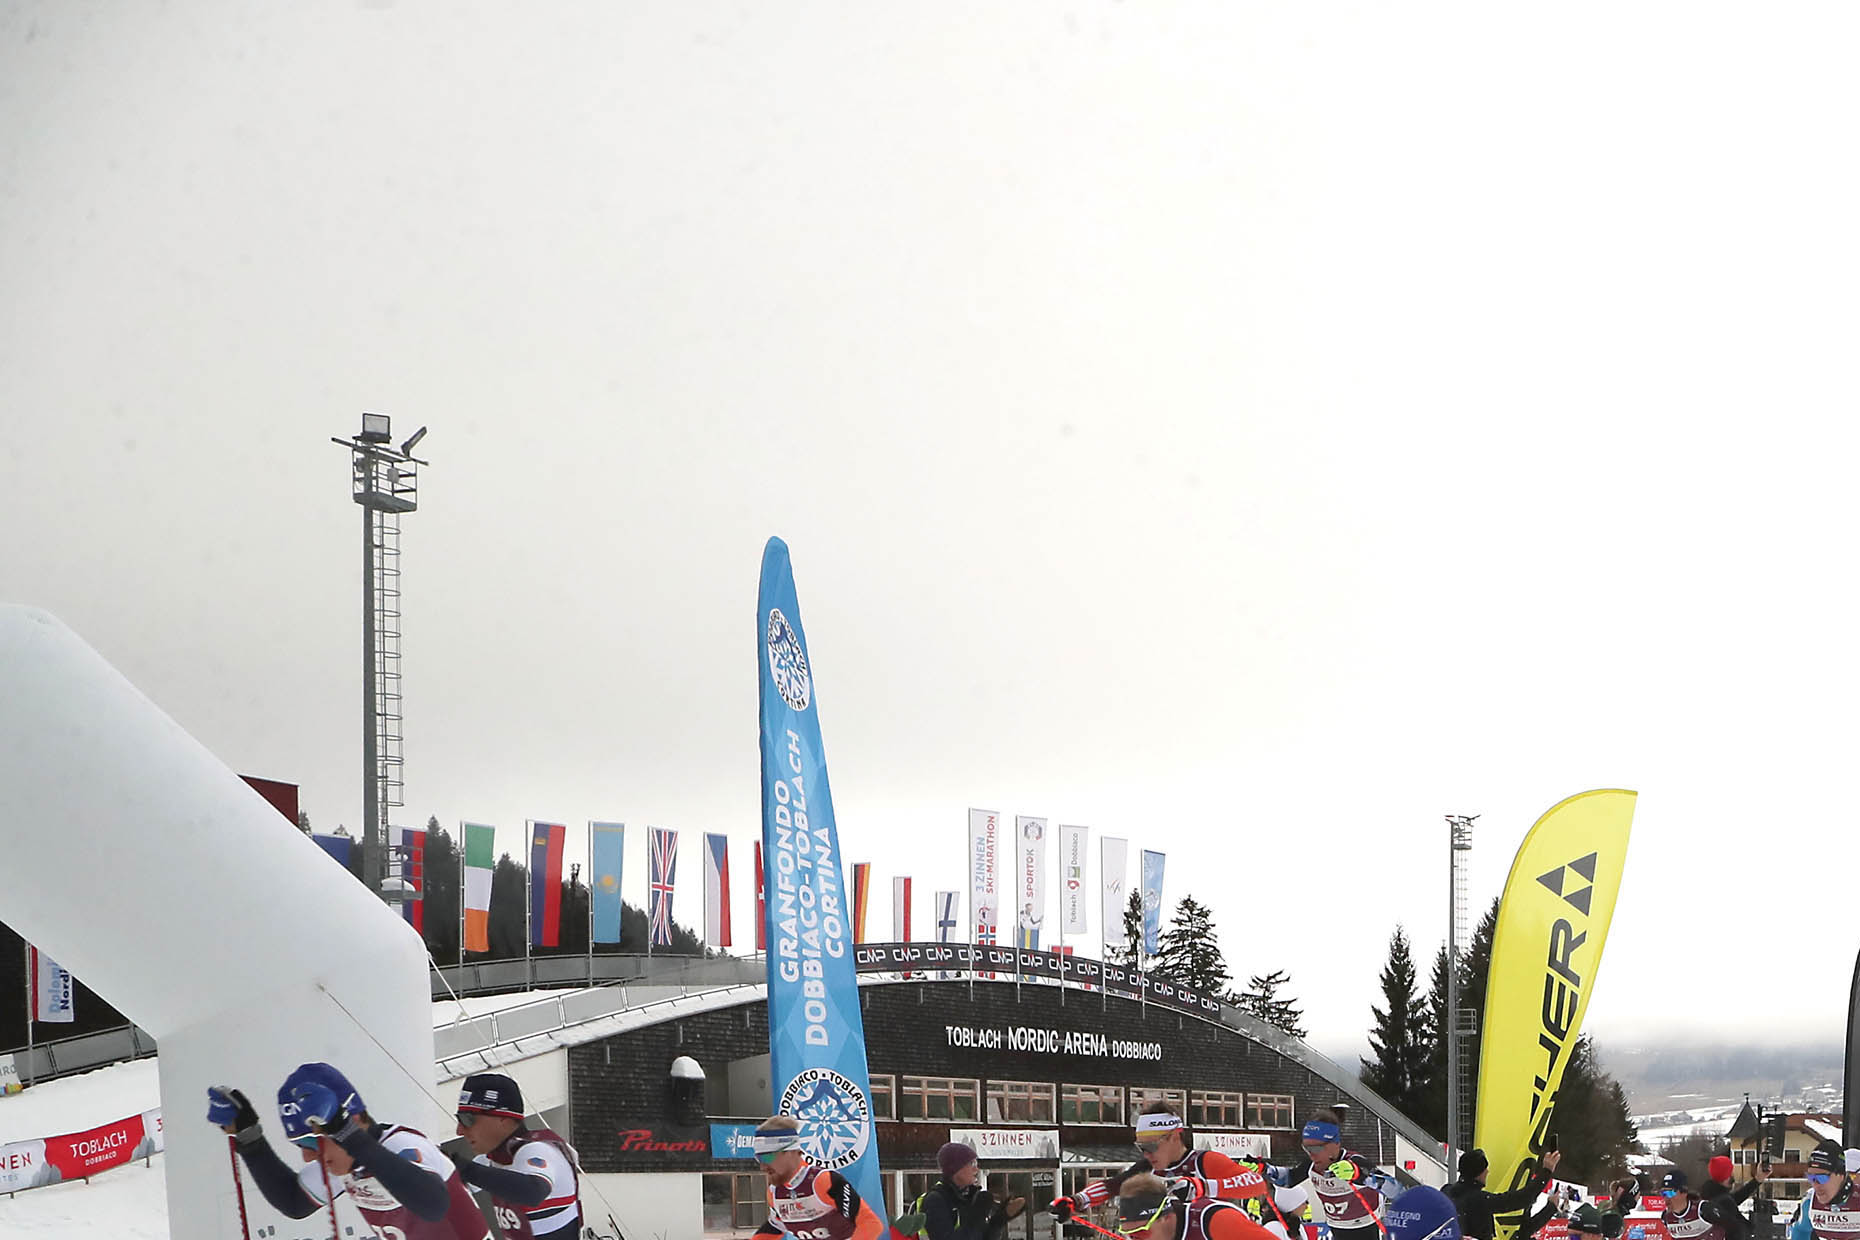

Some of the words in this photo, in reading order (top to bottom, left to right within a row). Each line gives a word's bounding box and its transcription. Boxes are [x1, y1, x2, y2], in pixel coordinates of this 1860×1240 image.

[976, 836, 985, 884] ZINNEN
[986, 815, 996, 894] SKI-MARATHON
[1026, 848, 1034, 898] SPORTOK
[775, 780, 799, 982] GRANFONDO
[786, 729, 829, 1047] DOBBIACO-TOBLACH
[814, 828, 844, 958] CORTINA
[946, 1026, 1001, 1049] TOBLACH
[1008, 1027, 1059, 1054] NORDIC
[1064, 1032, 1108, 1057] ARENA
[1112, 1040, 1162, 1061] DOBBIACO
[829, 1071, 868, 1116] TOBLACH
[69, 1130, 128, 1158] TOBLACH
[1827, 1214, 1849, 1224] ITAS
